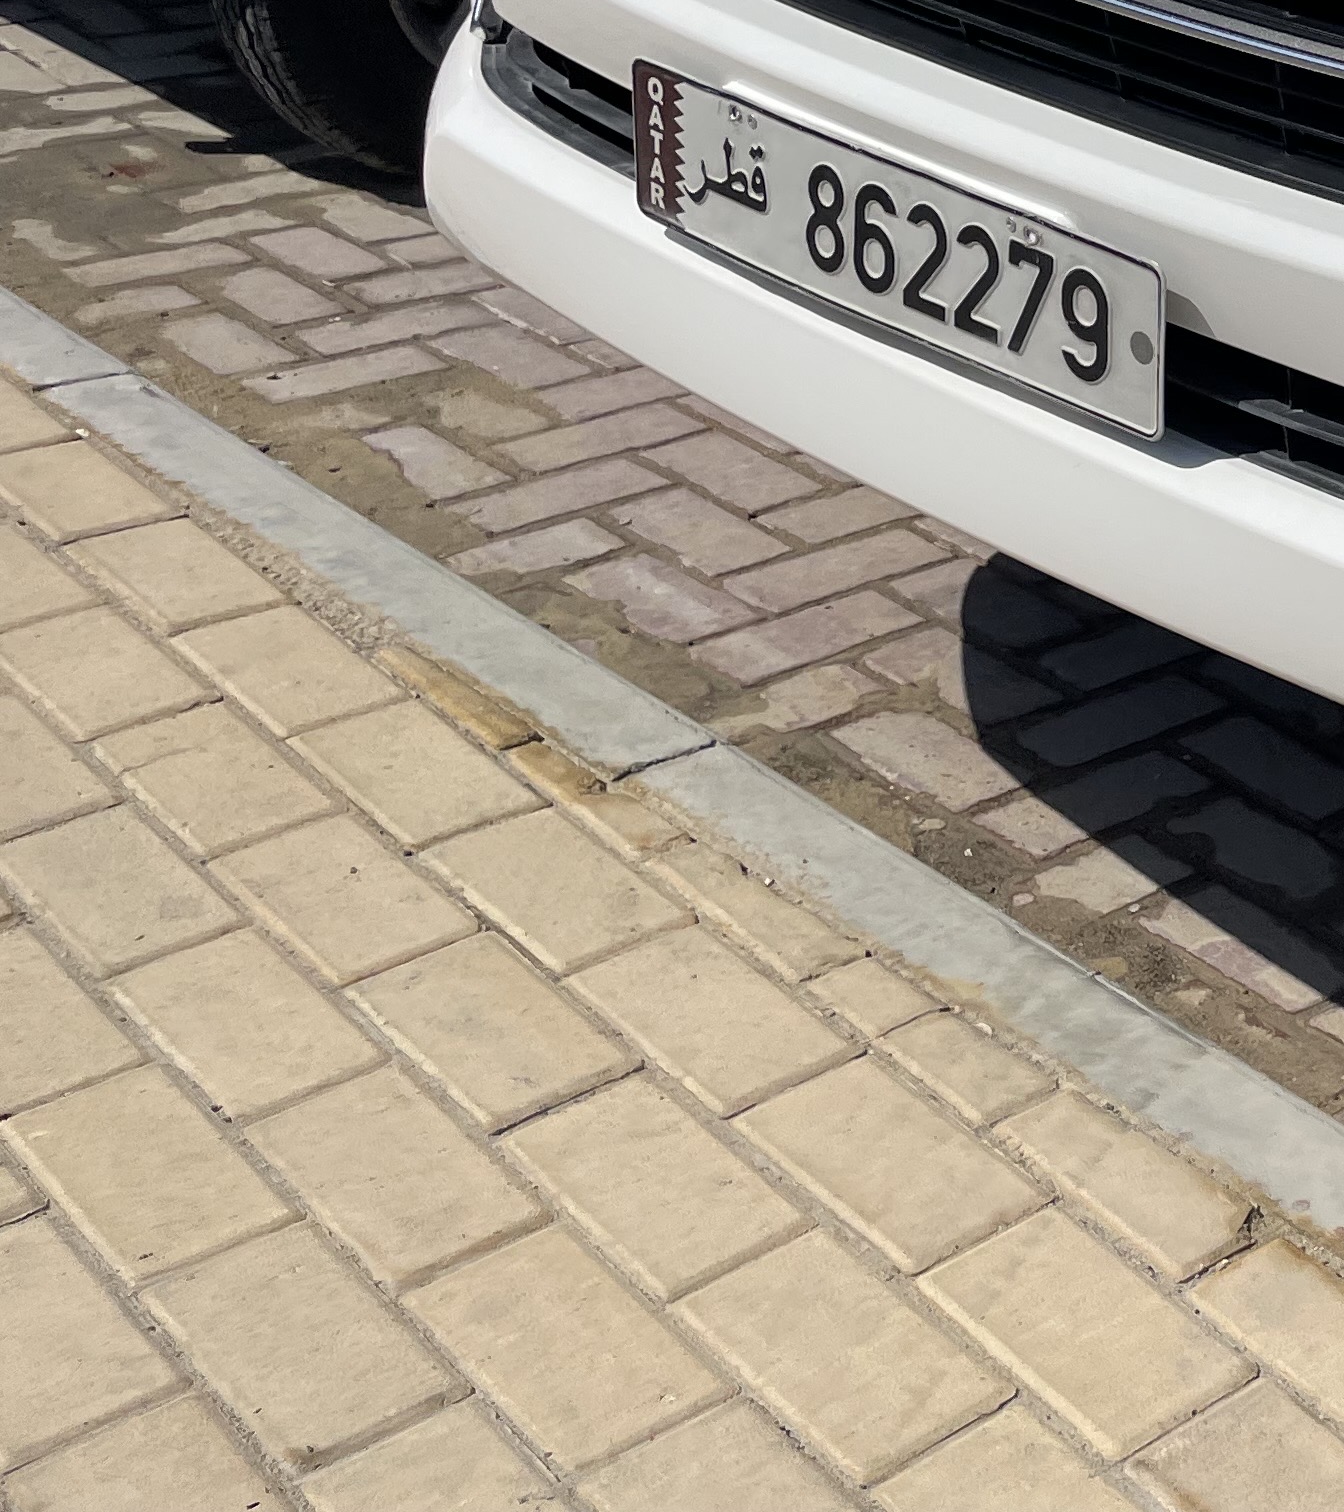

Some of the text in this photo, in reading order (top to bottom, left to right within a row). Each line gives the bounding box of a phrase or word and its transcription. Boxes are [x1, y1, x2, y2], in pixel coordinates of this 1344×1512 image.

[646, 75, 667, 211] QATAR
[683, 137, 769, 214] قطر
[804, 162, 1111, 384] 862279
